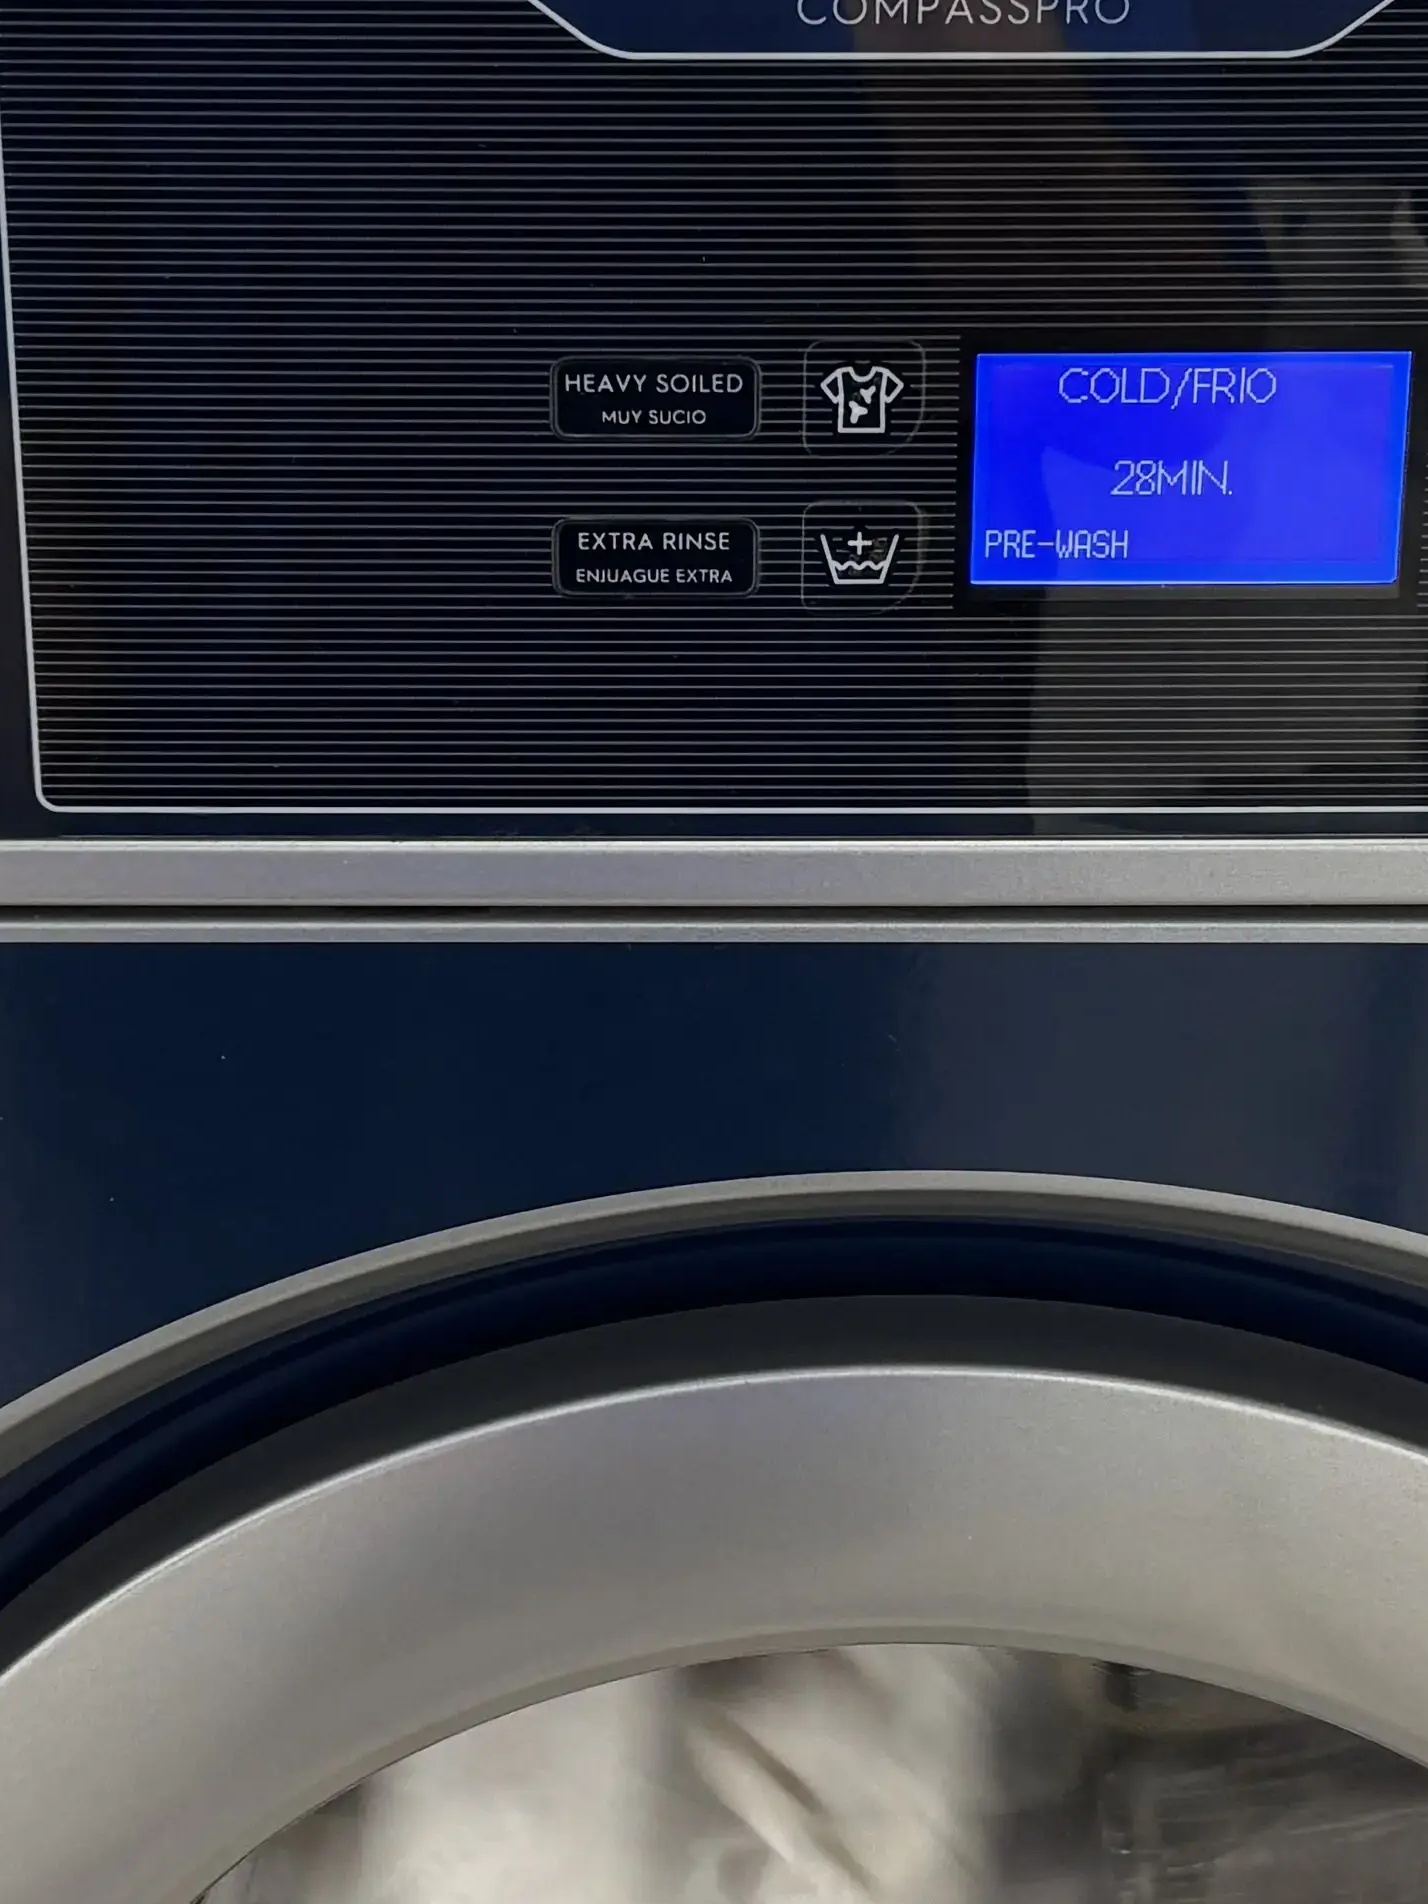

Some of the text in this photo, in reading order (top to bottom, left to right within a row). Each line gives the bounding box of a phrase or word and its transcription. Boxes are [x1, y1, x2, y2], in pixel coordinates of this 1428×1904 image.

[564, 373, 743, 394] HEAVY SOILED
[1058, 367, 1277, 410] COLD/FRIO
[601, 409, 707, 425] MUY SUCIO
[577, 531, 730, 552] EXTRA RINSE
[984, 528, 1128, 559] PRE-WASH
[575, 569, 733, 585] ENJUAGUE EXTRA
